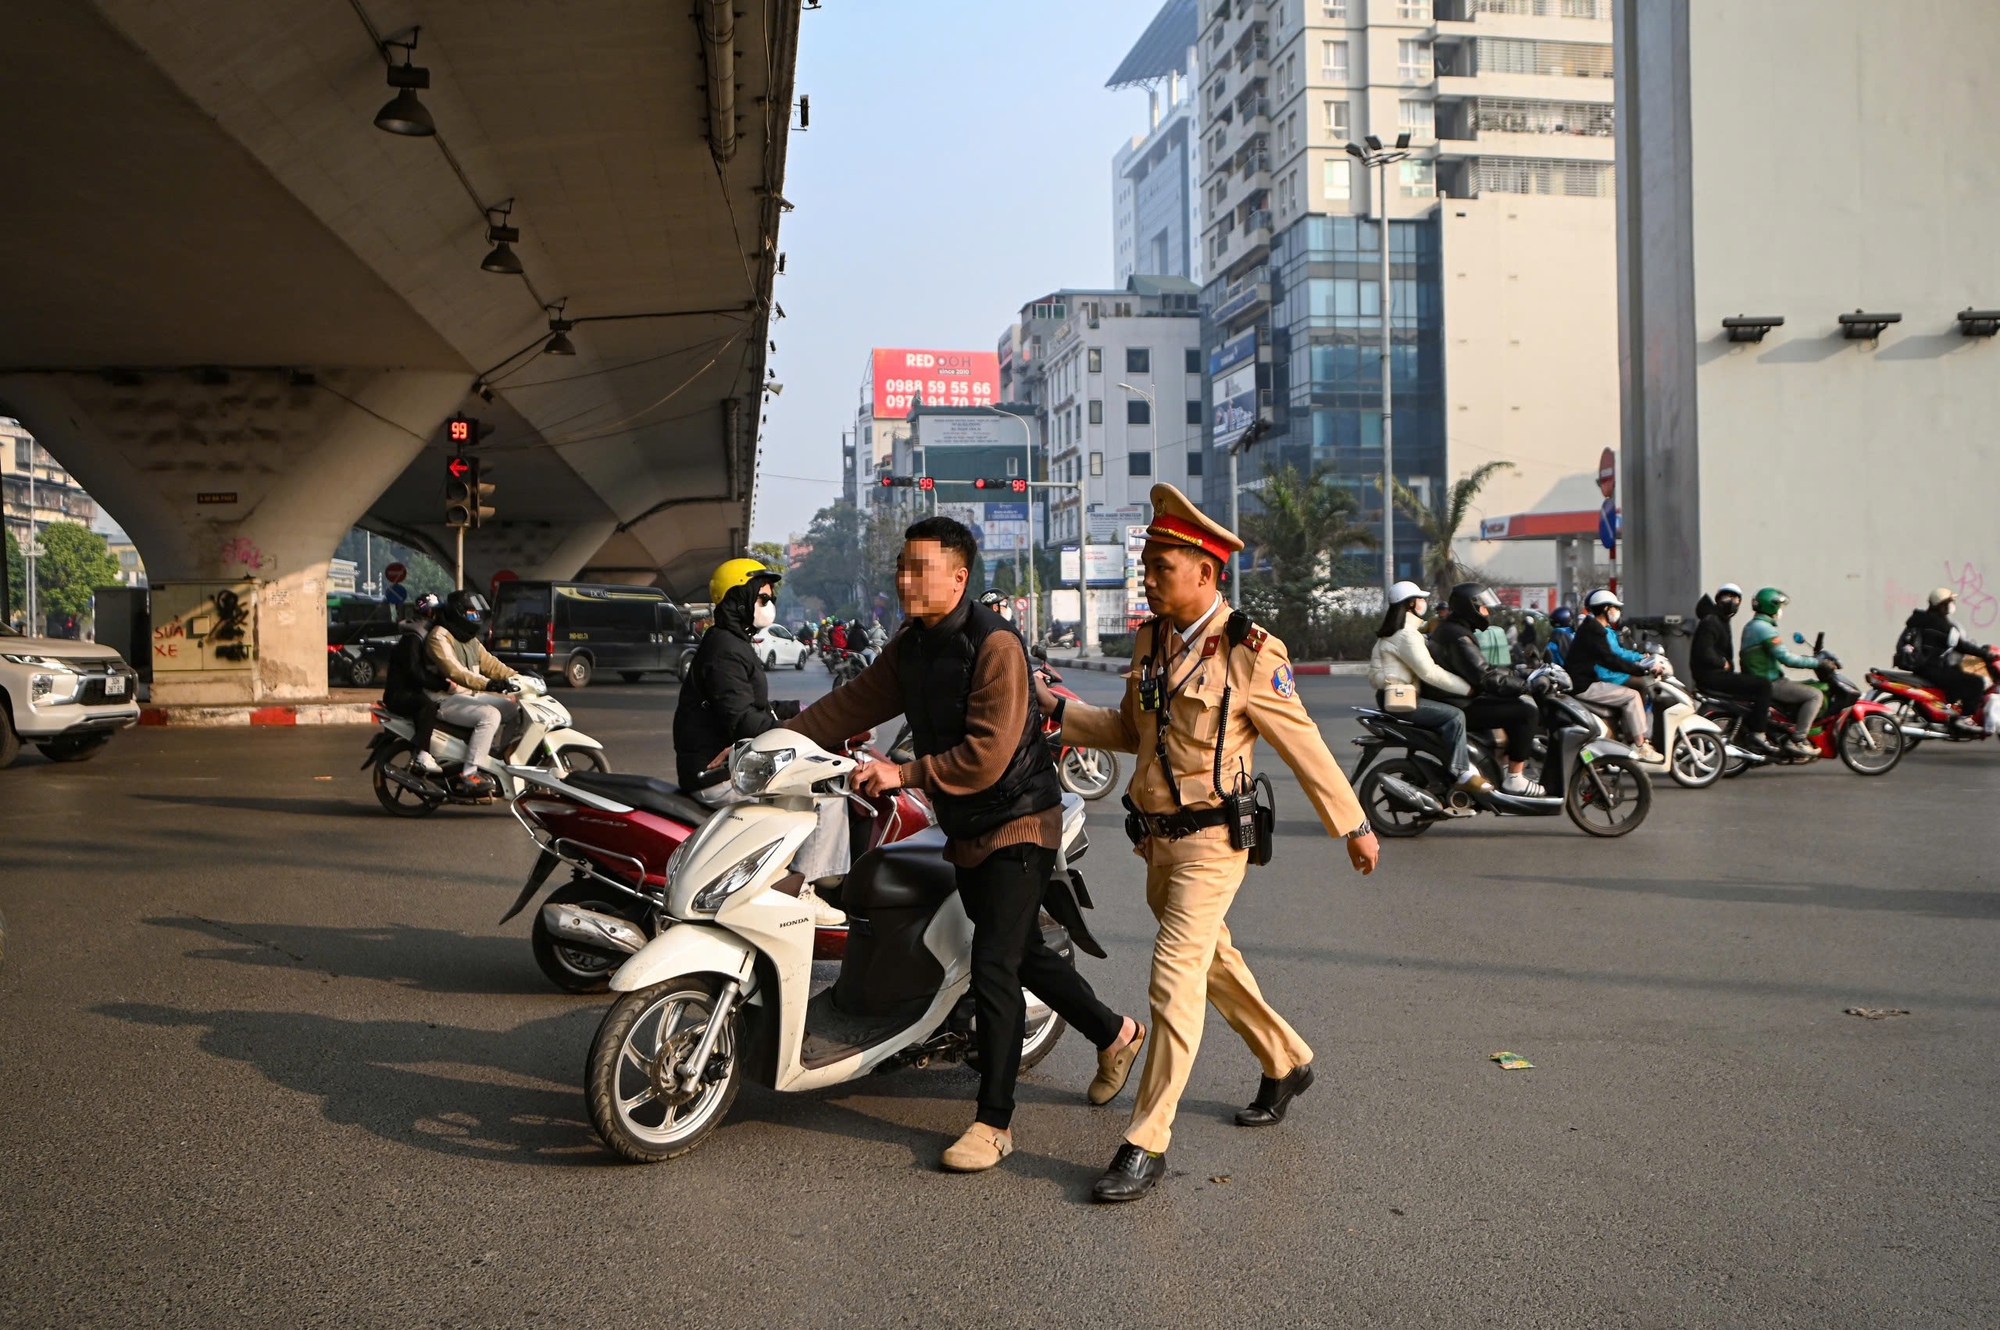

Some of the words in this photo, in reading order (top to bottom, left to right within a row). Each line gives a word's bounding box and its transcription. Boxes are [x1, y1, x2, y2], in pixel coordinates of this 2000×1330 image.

[906, 353, 935, 367] RED
[886, 379, 923, 393] 0988
[928, 380, 946, 393] 59
[950, 381, 968, 394] 55
[972, 382, 991, 395] 66
[886, 394, 922, 408] 097
[451, 421, 467, 440] 99
[919, 478, 933, 489] 99
[1012, 480, 1026, 492] 99
[154, 644, 178, 656] XE
[779, 917, 809, 928] HONDA
